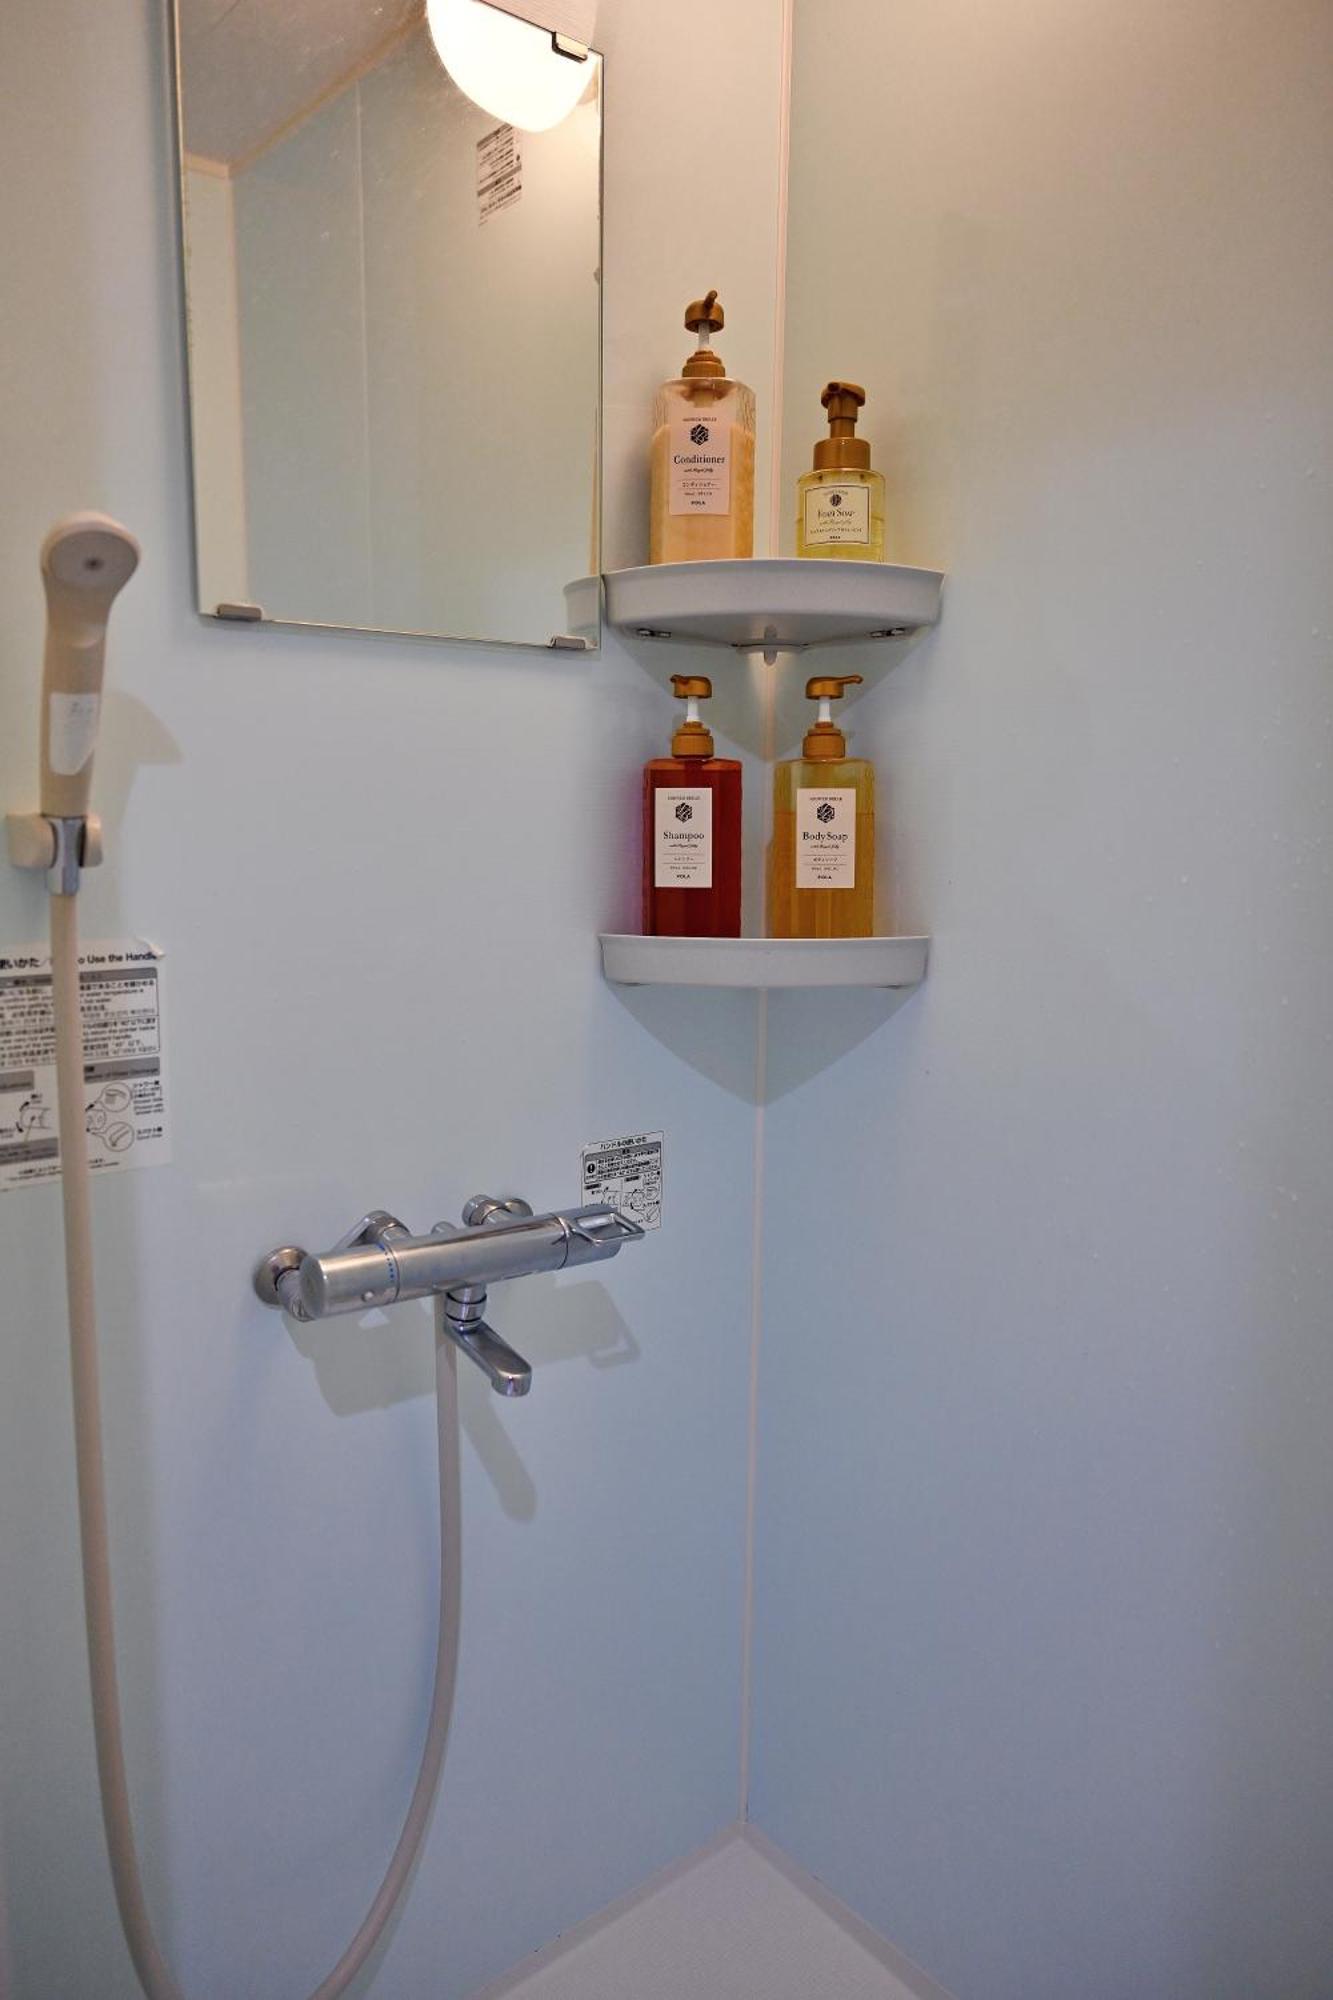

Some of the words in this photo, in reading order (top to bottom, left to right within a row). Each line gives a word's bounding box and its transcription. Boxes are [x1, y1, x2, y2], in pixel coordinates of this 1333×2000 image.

[673, 454, 726, 465] Conditioner
[663, 830, 705, 843] Shampoo
[802, 831, 826, 844] Body
[827, 831, 849, 844] Soap
[87, 953, 107, 964] Use
[108, 951, 123, 963] the
